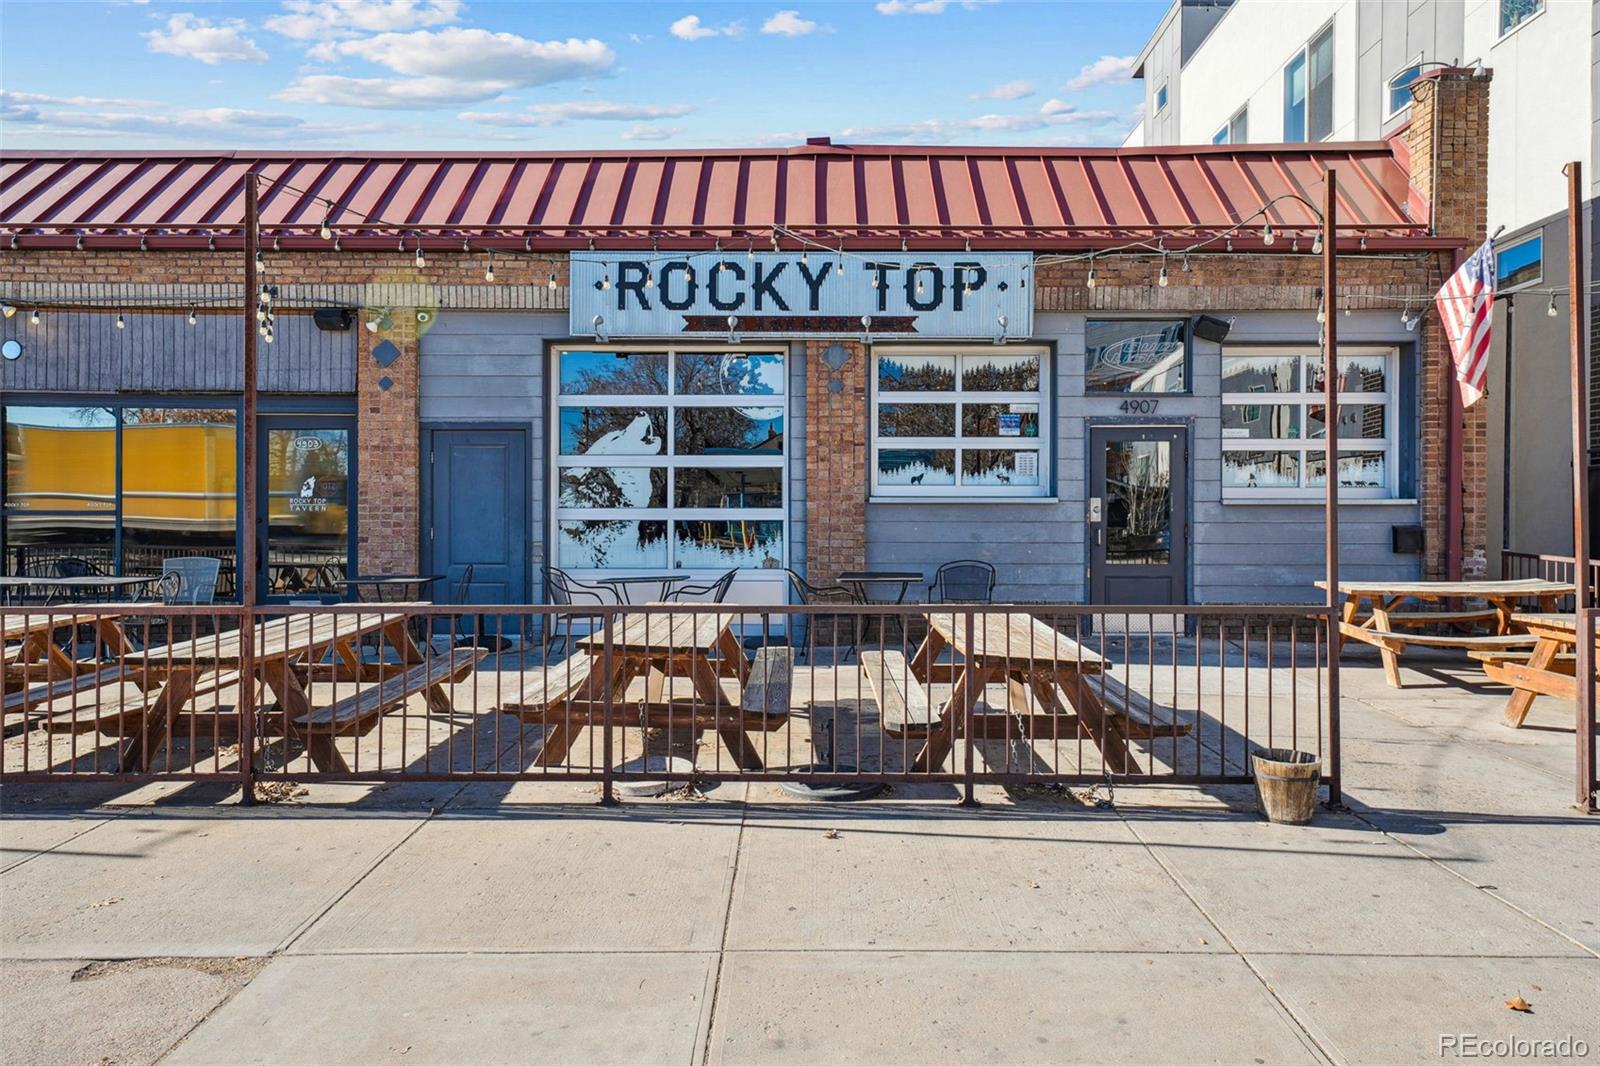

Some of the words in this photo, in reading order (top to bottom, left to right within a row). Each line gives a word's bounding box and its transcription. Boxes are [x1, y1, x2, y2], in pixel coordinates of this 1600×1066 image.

[615, 261, 833, 311] ROCKY
[862, 261, 987, 311] TOP
[1119, 400, 1159, 414] 4907
[296, 440, 319, 448] 4903
